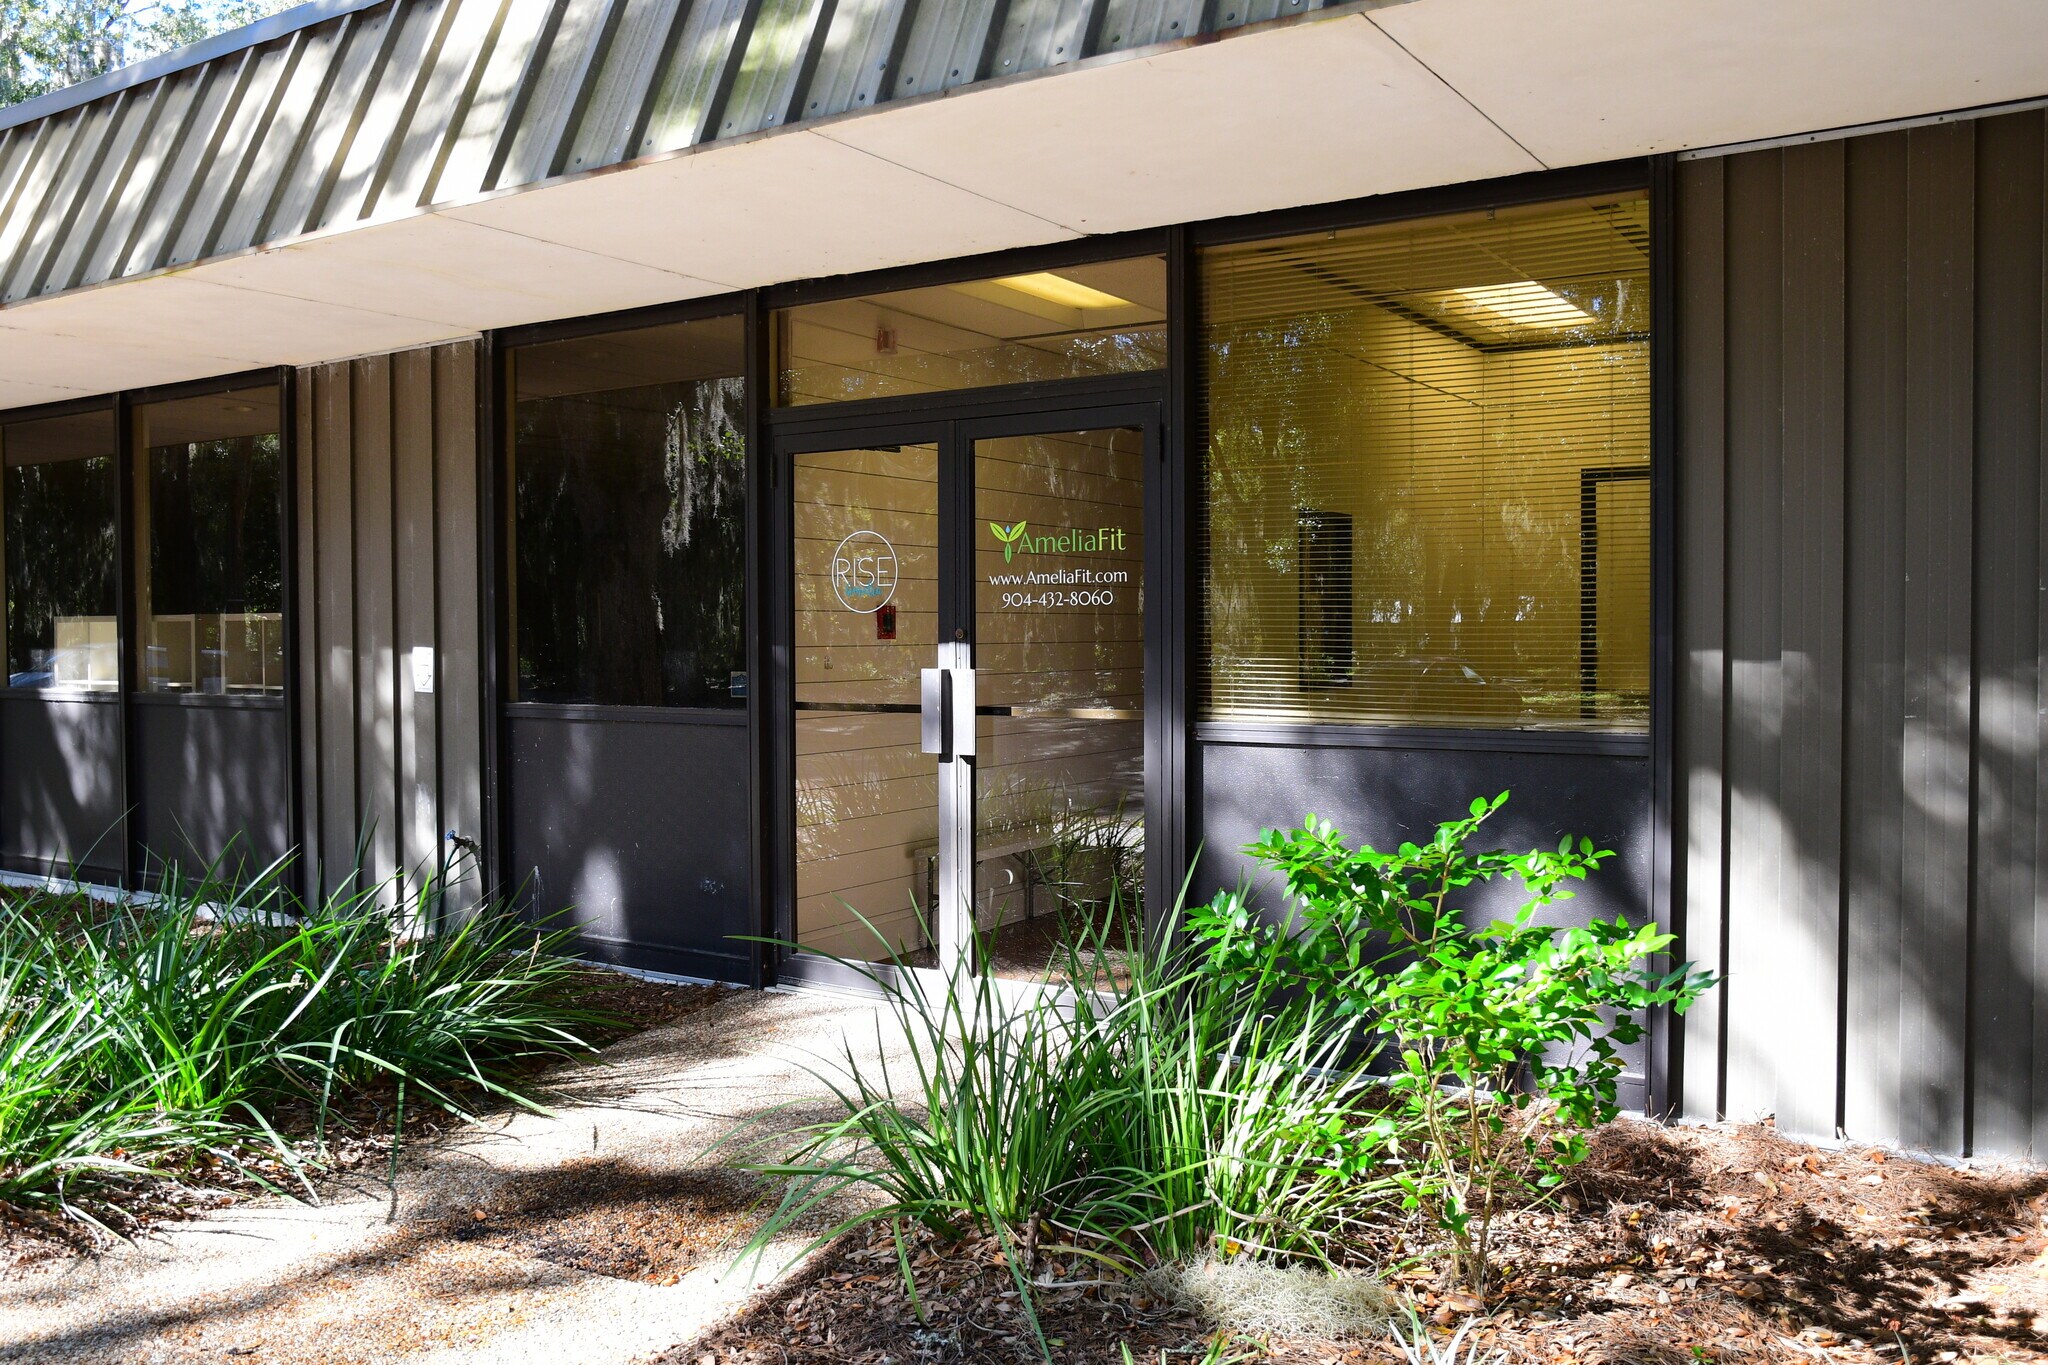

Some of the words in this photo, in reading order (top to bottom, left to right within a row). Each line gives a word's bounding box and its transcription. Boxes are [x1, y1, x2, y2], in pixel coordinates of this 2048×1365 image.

[1017, 527, 1127, 554] AmeliaFit
[836, 556, 893, 588] RISE
[989, 568, 1128, 586] www.AmeliaFit.com
[1001, 589, 1114, 609] 904-432-8060
